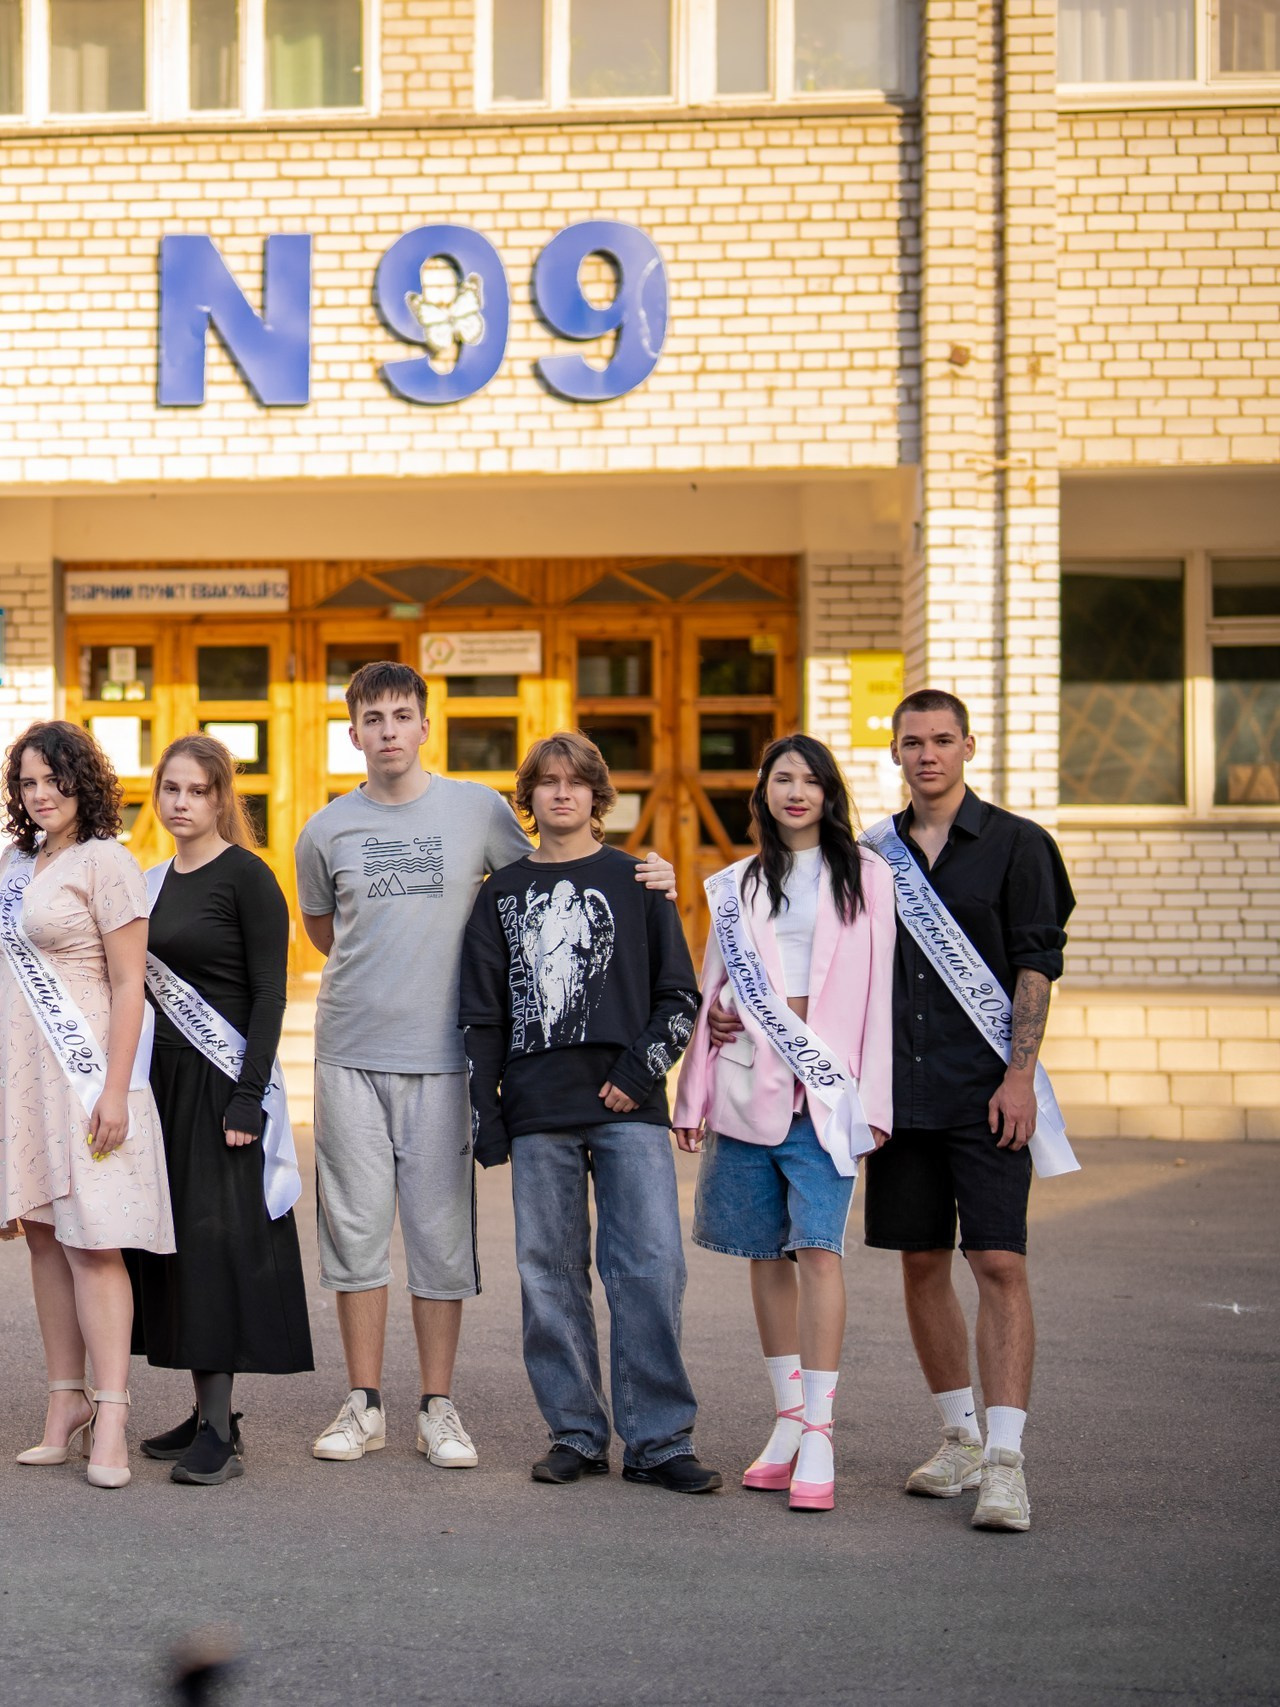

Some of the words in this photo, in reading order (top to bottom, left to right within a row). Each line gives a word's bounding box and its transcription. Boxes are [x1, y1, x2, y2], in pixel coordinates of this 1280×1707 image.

[374, 220, 668, 404] 99
[1, 874, 61, 1018] Випускниця
[54, 1019, 103, 1075] 2025
[42, 969, 64, 1001] Марія
[497, 895, 525, 1051] EMPTINESS
[887, 846, 973, 981] Випускник
[967, 982, 1012, 1042] 2025
[919, 882, 948, 928] Сироватка
[145, 960, 228, 1053] ипускниця
[717, 896, 786, 1037] Випускниця
[784, 1035, 845, 1087] 2025
